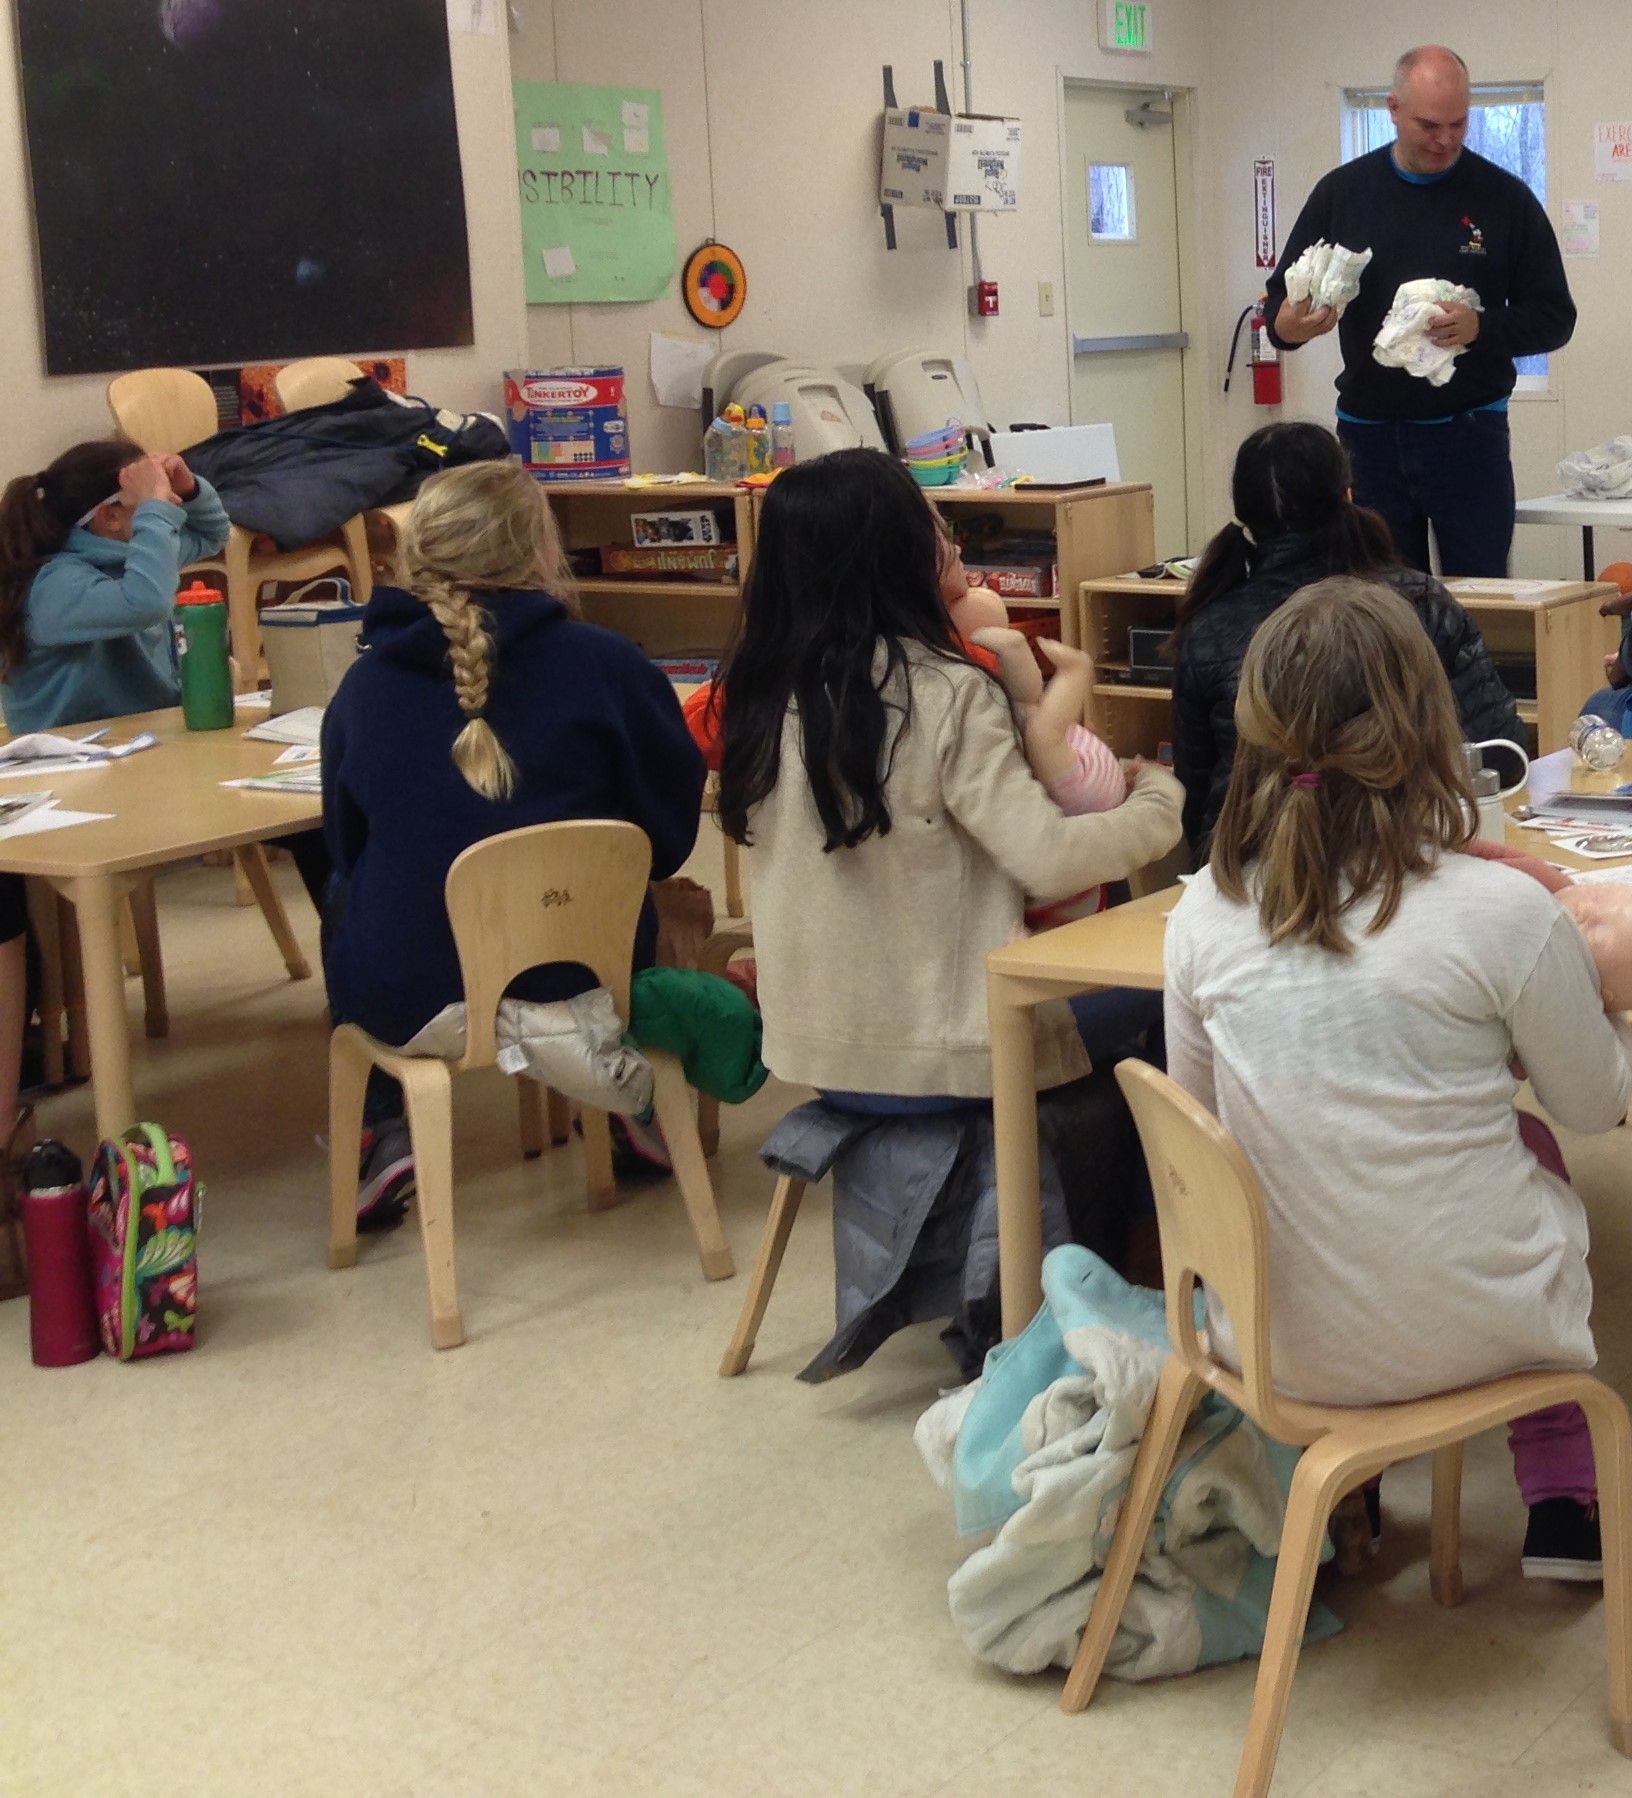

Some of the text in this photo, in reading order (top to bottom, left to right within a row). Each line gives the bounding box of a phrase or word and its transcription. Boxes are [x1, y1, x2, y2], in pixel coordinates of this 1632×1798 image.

[1115, 2, 1146, 47] EXIT
[1256, 166, 1272, 176] FIRE
[518, 169, 660, 210] SIBILITY
[1261, 178, 1269, 261] EXTINGUISHER
[526, 385, 590, 399] TINKERTOY
[657, 548, 717, 570] JUMANJI
